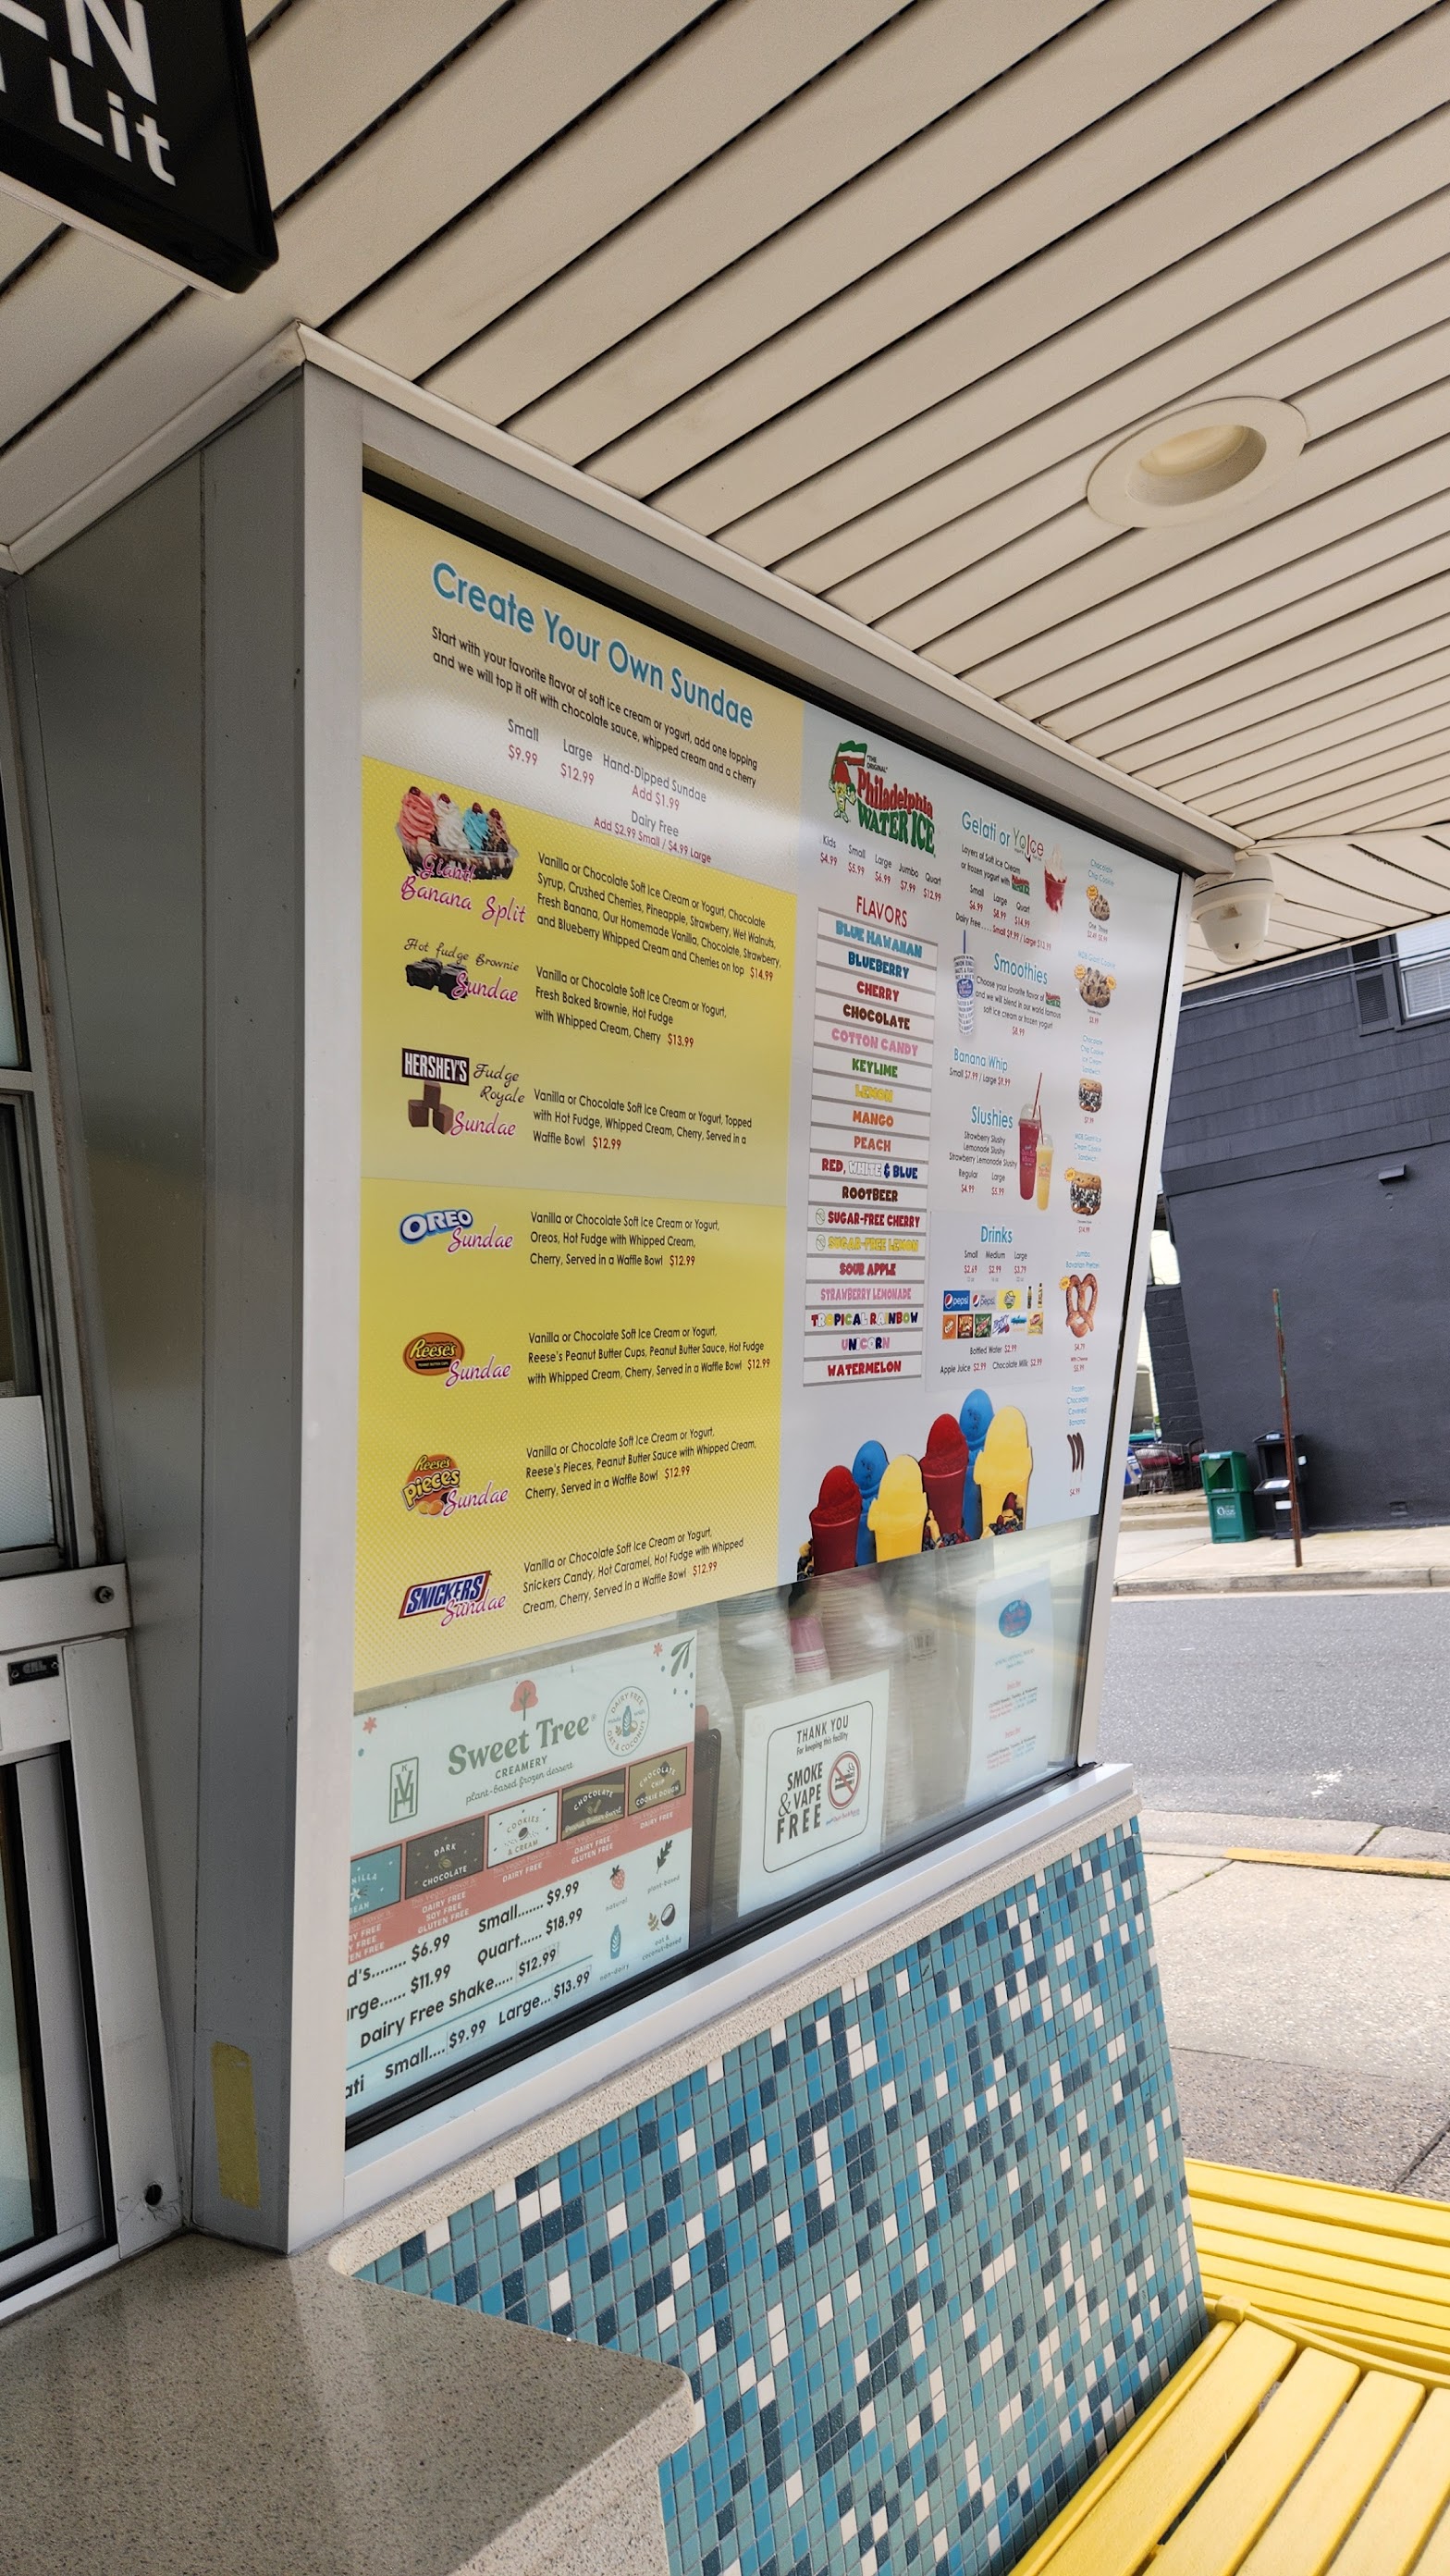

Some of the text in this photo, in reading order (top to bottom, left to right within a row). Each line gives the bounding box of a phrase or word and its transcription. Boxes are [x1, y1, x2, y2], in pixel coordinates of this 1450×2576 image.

[49, 56, 176, 187] Lit
[432, 562, 754, 730] Create Your Own Sundae
[431, 625, 456, 647] Start
[458, 639, 480, 658] with
[483, 649, 507, 667] your
[509, 657, 546, 684] favorite
[548, 673, 575, 696] flavor
[577, 687, 587, 700] of
[588, 693, 605, 708] soft
[607, 696, 621, 714] ice
[622, 708, 651, 726] cream
[653, 720, 662, 731] or
[694, 736, 710, 750] add
[712, 744, 727, 758] one
[729, 747, 757, 771] topping
[508, 719, 707, 803] Small Large Hand-Dipped Sundae
[508, 744, 680, 811] $9.99 $12.99 Add $1.99
[857, 768, 933, 820] Philadelphia
[632, 810, 679, 837] Dairy Free
[857, 798, 935, 855] WATER ICE
[962, 810, 996, 844] Gelati
[999, 832, 1011, 845] or
[594, 817, 611, 832] Add
[615, 822, 635, 840] $2.99
[639, 830, 661, 847] Small
[669, 838, 688, 857] $4.99
[690, 845, 711, 864] Large
[421, 854, 476, 882] Giant!
[823, 835, 940, 885] Kids Small Large Jumbo Quart
[820, 853, 941, 902] $4.99 $5.99 $6.99 $7.99 $12.99
[400, 874, 526, 927] Banana Split
[857, 895, 907, 928] FLAVORS
[970, 884, 1029, 913] Small Large Quart
[969, 900, 1029, 928] $6.99 $8.99 $14.99
[836, 920, 864, 939] BLUE
[403, 938, 429, 952] Hot
[475, 953, 519, 972] Brownie
[848, 952, 909, 980] BLUEBERRY
[993, 953, 1048, 985] Smoothies
[451, 971, 519, 1004] Sundae
[857, 981, 899, 1002] CHERRY
[535, 1009, 694, 1048] with Whipped Cream, Cherry $13.99
[843, 1004, 910, 1030] CHOCOLATE
[1013, 1026, 1025, 1037] $8.99
[831, 1028, 918, 1056] COTTON CANDY
[404, 1052, 519, 1086] HERSHEY'S Fudge
[852, 1058, 898, 1078] KEYLIME
[953, 1048, 1008, 1073] Banana Whip
[479, 1085, 524, 1107] Royale
[855, 1084, 893, 1103] LEMON
[449, 1111, 516, 1137] Sundae
[853, 1111, 894, 1127] MANGO
[971, 1105, 1014, 1129] Slushies
[854, 1136, 891, 1152] PEACH
[821, 1158, 917, 1179] RED, WHITE & BLUE
[842, 1186, 898, 1202] ROOTBEER
[400, 1210, 473, 1241] OREO
[828, 1211, 920, 1227] SUGAR-FREE CHERRY
[447, 1225, 513, 1252] Sundae
[828, 1237, 918, 1252] SUGAR-FREE LEMON
[980, 1226, 1013, 1244] Drinks
[529, 1252, 694, 1267] Cherry, Served in a Waffle Bowl $12.99
[840, 1263, 896, 1276] SOUR APPLE
[820, 1288, 911, 1301] STRAWBERRY LEMONADE
[811, 1312, 918, 1326] TROPICAL RAINBOW
[842, 1337, 890, 1350] UNICORN
[445, 1355, 511, 1387] Sundae
[828, 1361, 902, 1377] WATERMELON
[442, 1482, 510, 1517] Sundae
[405, 1574, 485, 1612] SNICKERS
[440, 1585, 506, 1627] Sundae
[796, 1746, 805, 1756] For
[805, 1741, 822, 1754] keeping
[832, 1732, 848, 1743] facility
[797, 1716, 849, 1744] THANK YOU
[448, 1714, 590, 1776] Sweet Tree
[495, 1755, 547, 1779] CREAMERY
[787, 1762, 823, 1792] SMOKE
[465, 1761, 574, 1806] plant-based frozen dessert
[778, 1783, 821, 1818] & VAPE
[777, 1804, 821, 1844] FREE
[434, 1843, 456, 1856] DARK
[423, 1866, 467, 1887] CHOCOLATE
[547, 1880, 579, 1907] $9.99
[546, 1907, 583, 1936] $18.99
[412, 1933, 450, 1962] $6.99
[518, 1948, 556, 1978] $12.99
[411, 1965, 450, 1994] $11.99
[553, 1970, 590, 2000] $13.99
[361, 2001, 444, 2048] Dairy Free
[449, 2020, 486, 2049] $9.99
